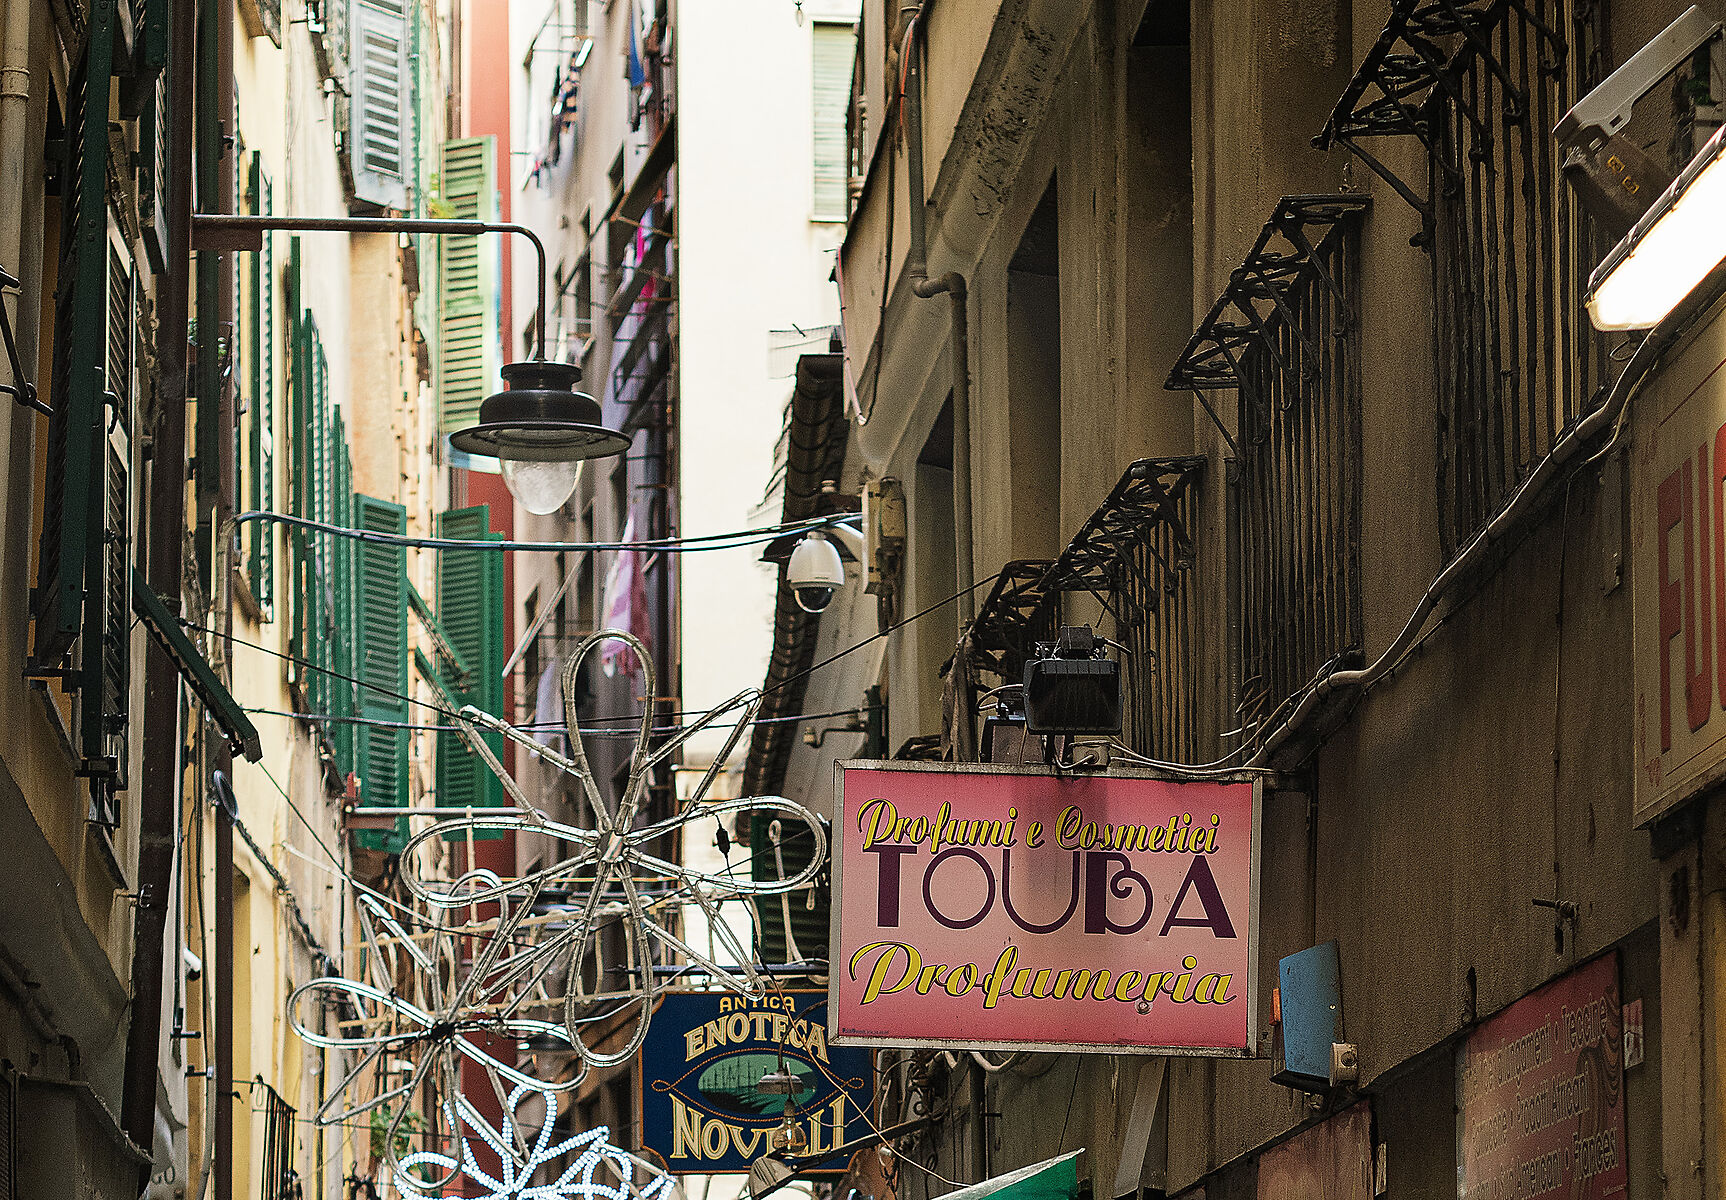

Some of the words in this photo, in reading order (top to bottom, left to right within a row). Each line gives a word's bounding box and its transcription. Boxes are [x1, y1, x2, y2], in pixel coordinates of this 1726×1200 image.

[857, 798, 1017, 853] Profumi
[1025, 820, 1046, 849] e
[1054, 805, 1221, 854] Cosmetici
[863, 843, 1238, 939] TOUBA
[849, 941, 1239, 1009] Profumeria
[683, 1011, 830, 1065] ENOTECA
